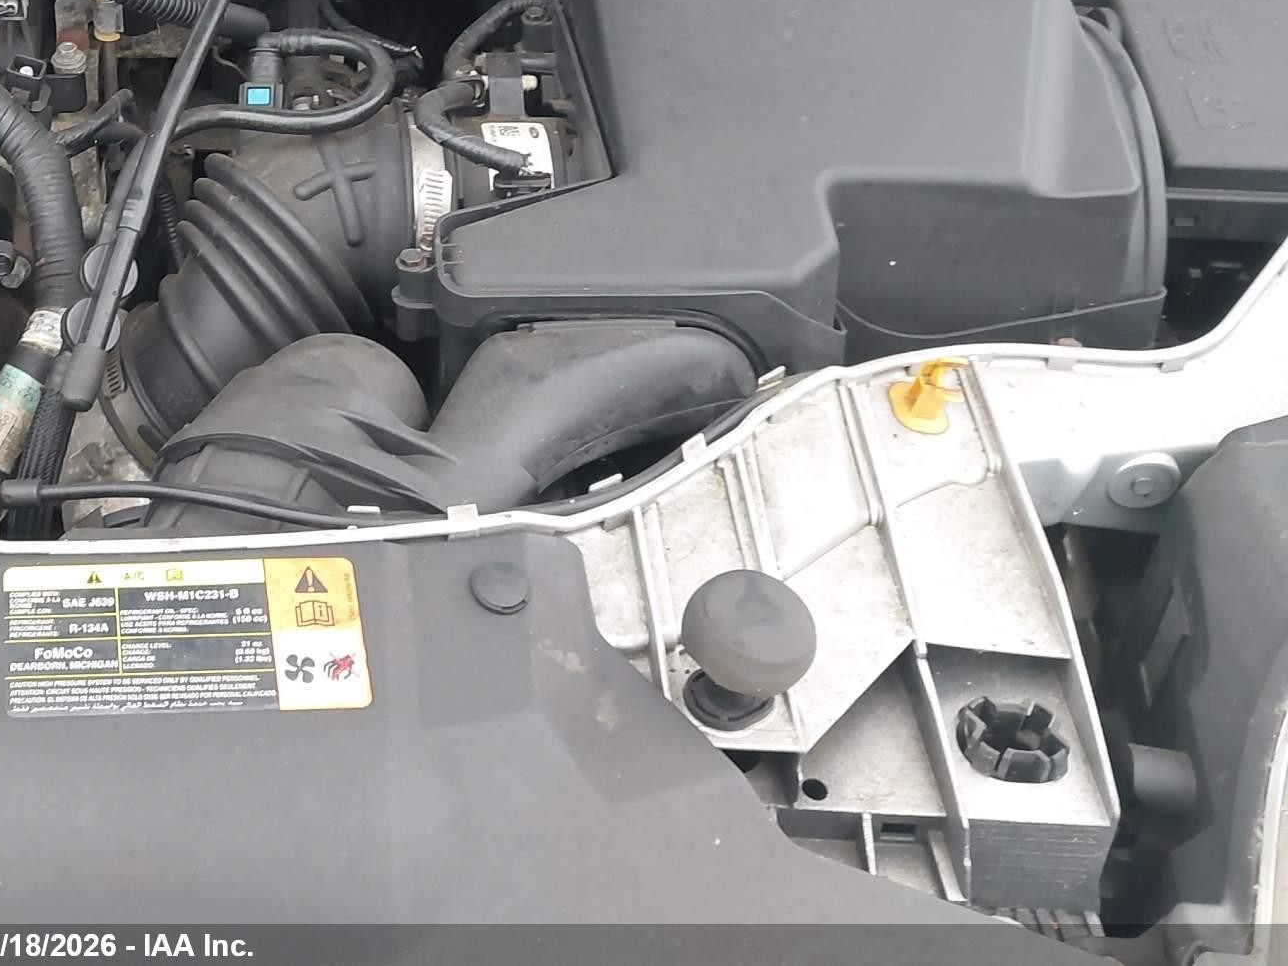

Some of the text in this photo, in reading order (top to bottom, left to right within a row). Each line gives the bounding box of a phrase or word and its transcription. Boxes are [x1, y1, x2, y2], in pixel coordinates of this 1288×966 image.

[144, 589, 239, 602] WSH-M1C231-B
[62, 597, 114, 608] SAE J639
[69, 622, 109, 634] R-134A
[34, 646, 94, 659] FoMoCo
[9, 659, 119, 672] DEARBORN, MICHIGAN
